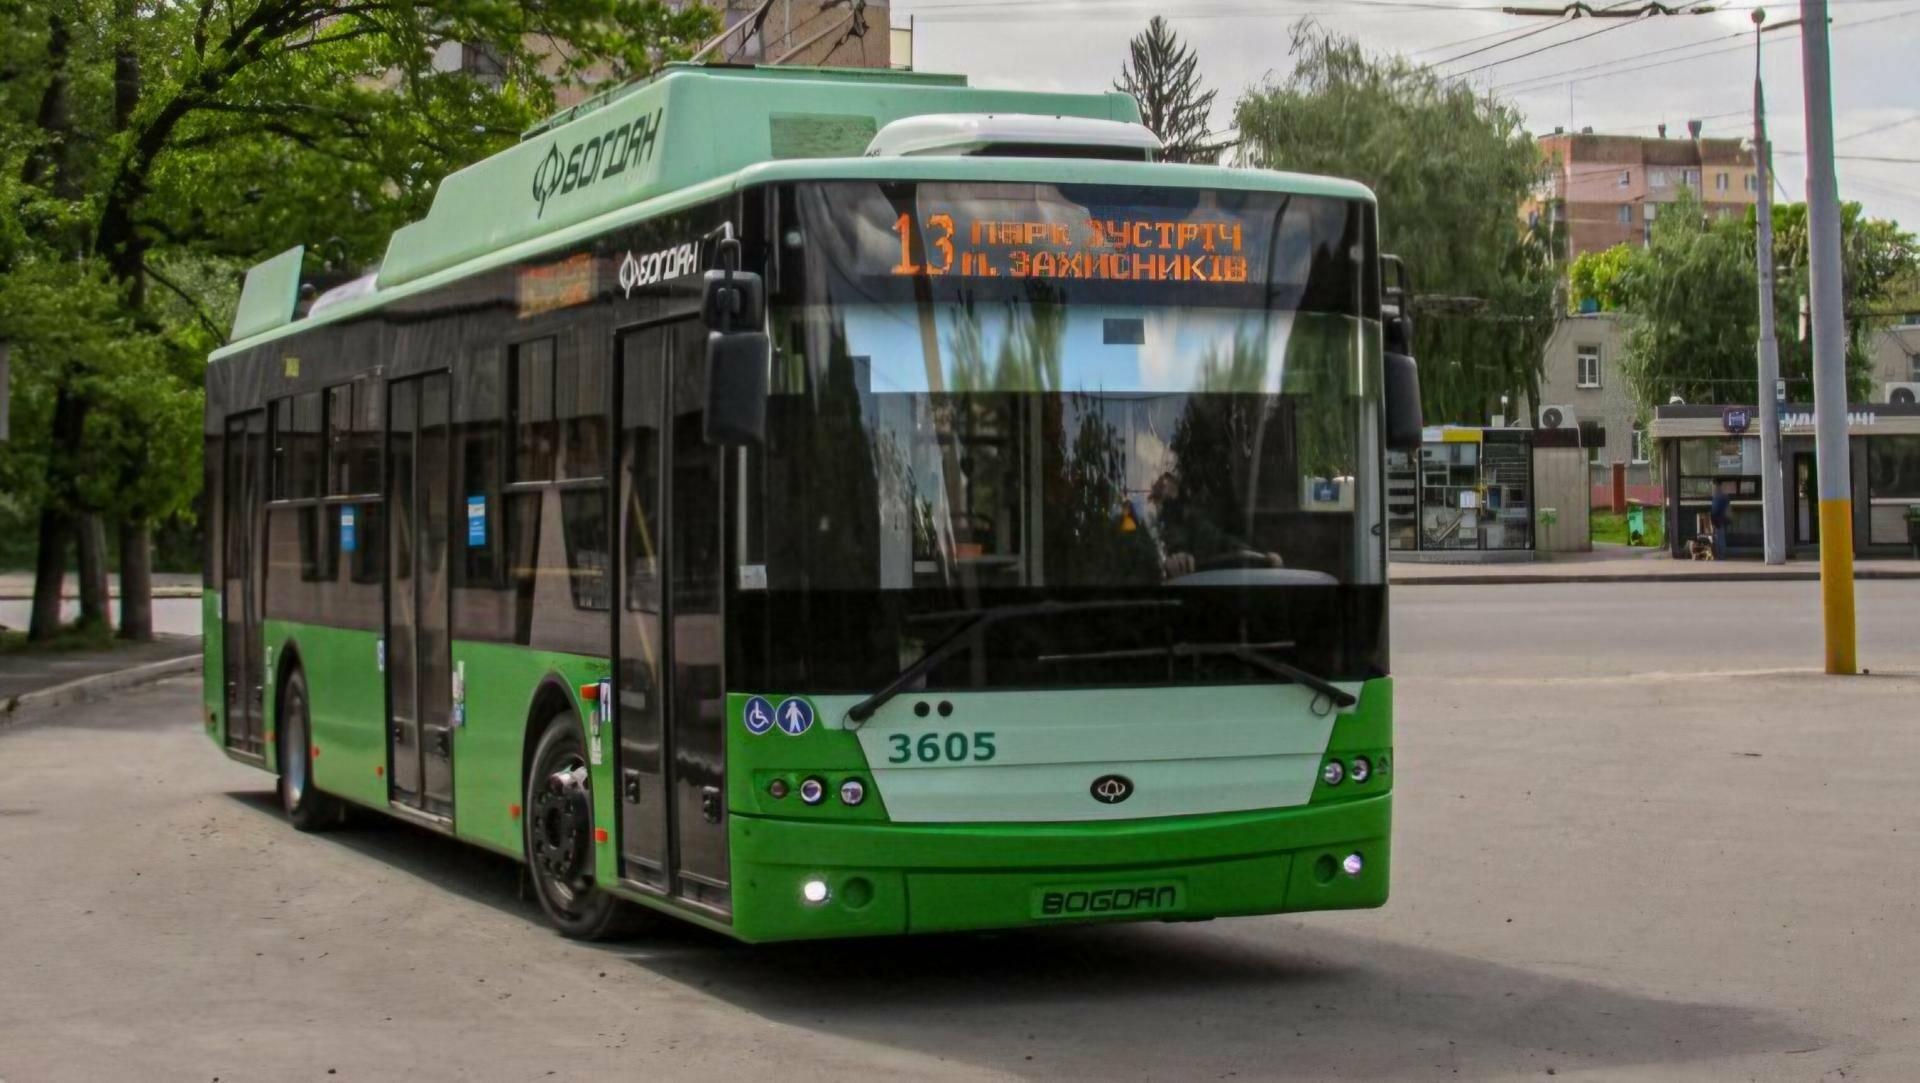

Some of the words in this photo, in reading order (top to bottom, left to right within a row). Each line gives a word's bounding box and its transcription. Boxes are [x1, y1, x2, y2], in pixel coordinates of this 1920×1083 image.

[560, 107, 663, 196] БОГДАН
[891, 213, 955, 275] 13
[970, 220, 1071, 246] ПАРК
[637, 241, 699, 287] БОГДАН
[1008, 251, 1247, 282] ЗАХИСНИКІВ
[888, 731, 997, 764] 3605
[1042, 886, 1176, 915] BOGDAN
